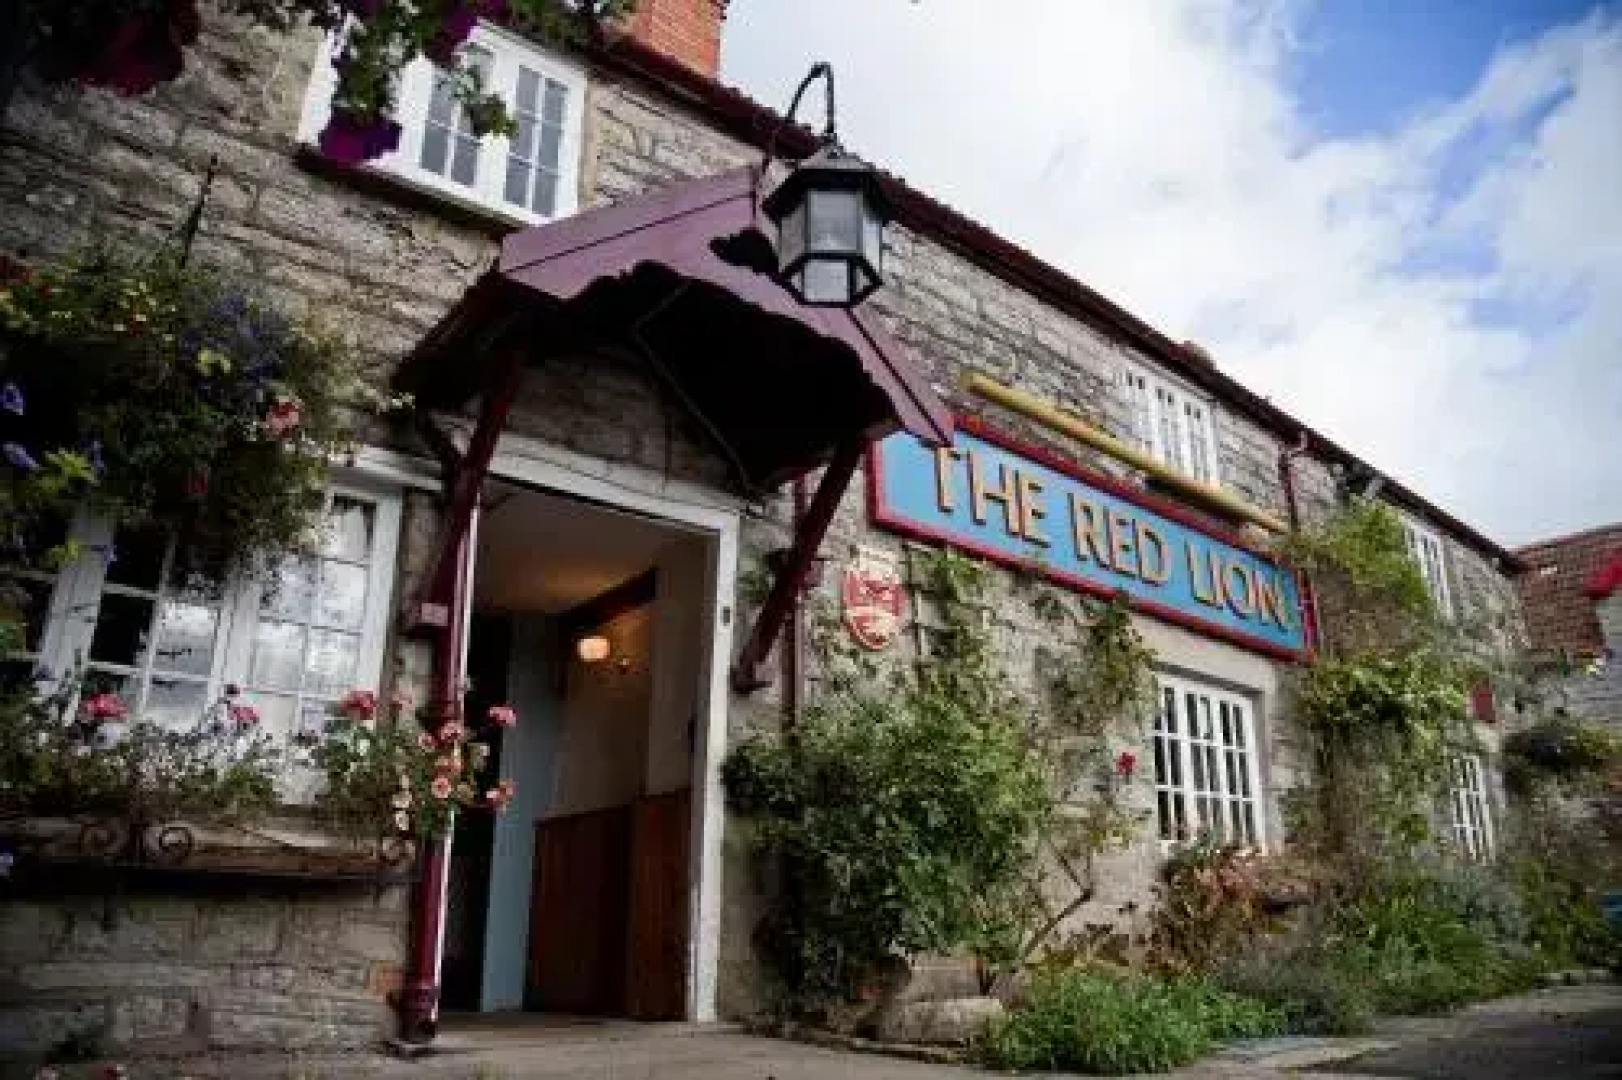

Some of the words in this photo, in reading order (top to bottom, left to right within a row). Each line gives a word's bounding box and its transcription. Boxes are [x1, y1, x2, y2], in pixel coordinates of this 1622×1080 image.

[934, 446, 1051, 548] THE
[1067, 493, 1171, 587] RED
[1185, 538, 1291, 632] LION
